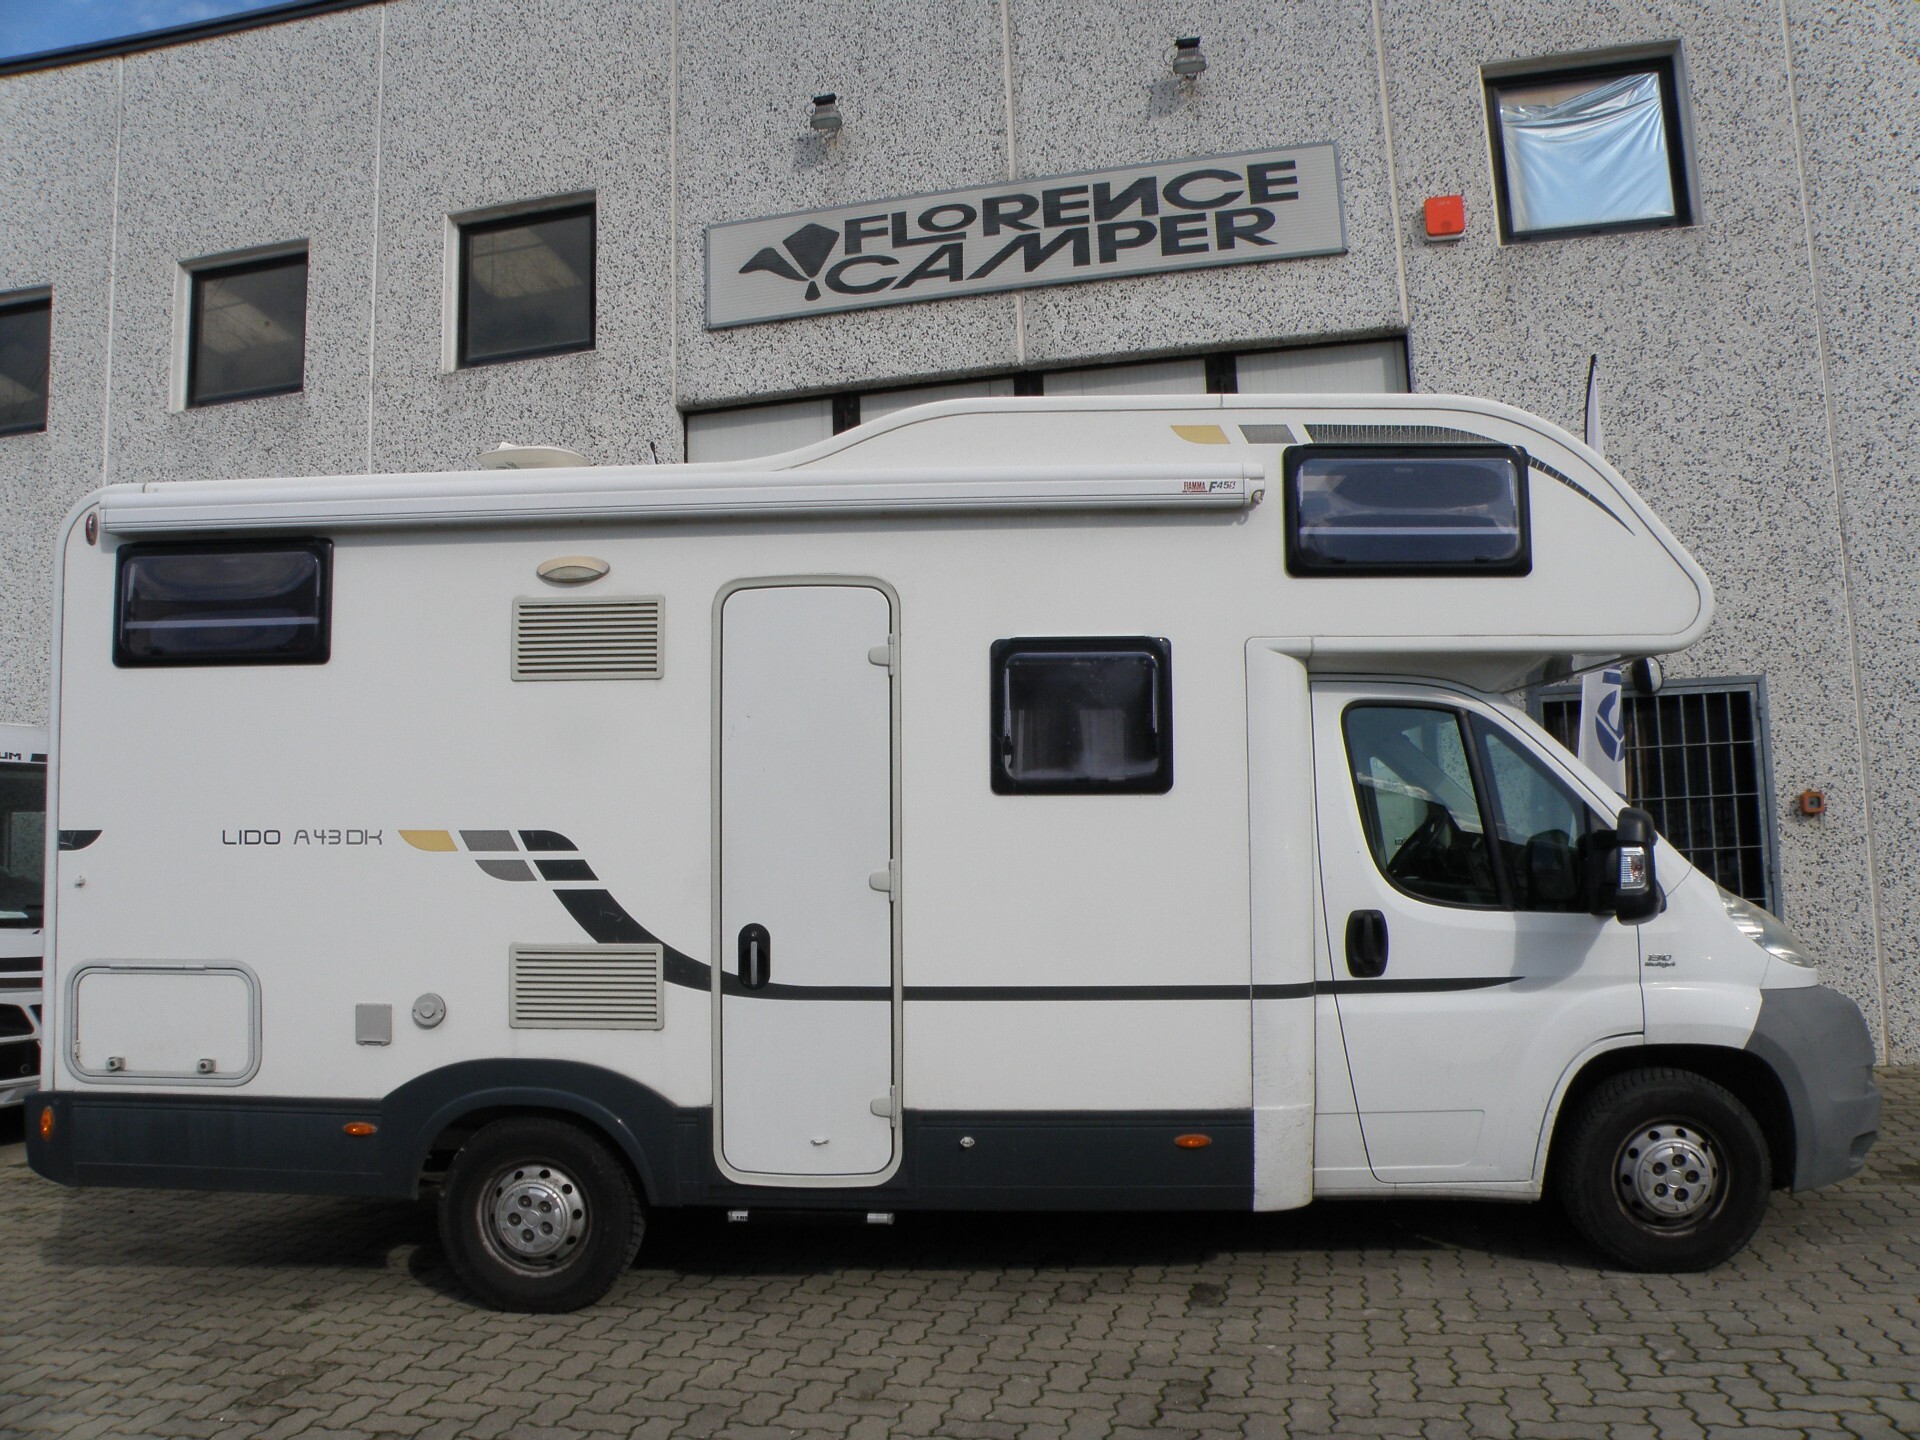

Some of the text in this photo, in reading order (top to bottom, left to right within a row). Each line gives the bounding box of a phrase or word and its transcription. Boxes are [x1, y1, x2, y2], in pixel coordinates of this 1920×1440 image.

[844, 160, 1299, 255] FLORENCE
[824, 206, 1279, 294] CAMPER
[1183, 481, 1206, 491] FIAMMA
[222, 829, 281, 845] LIDO
